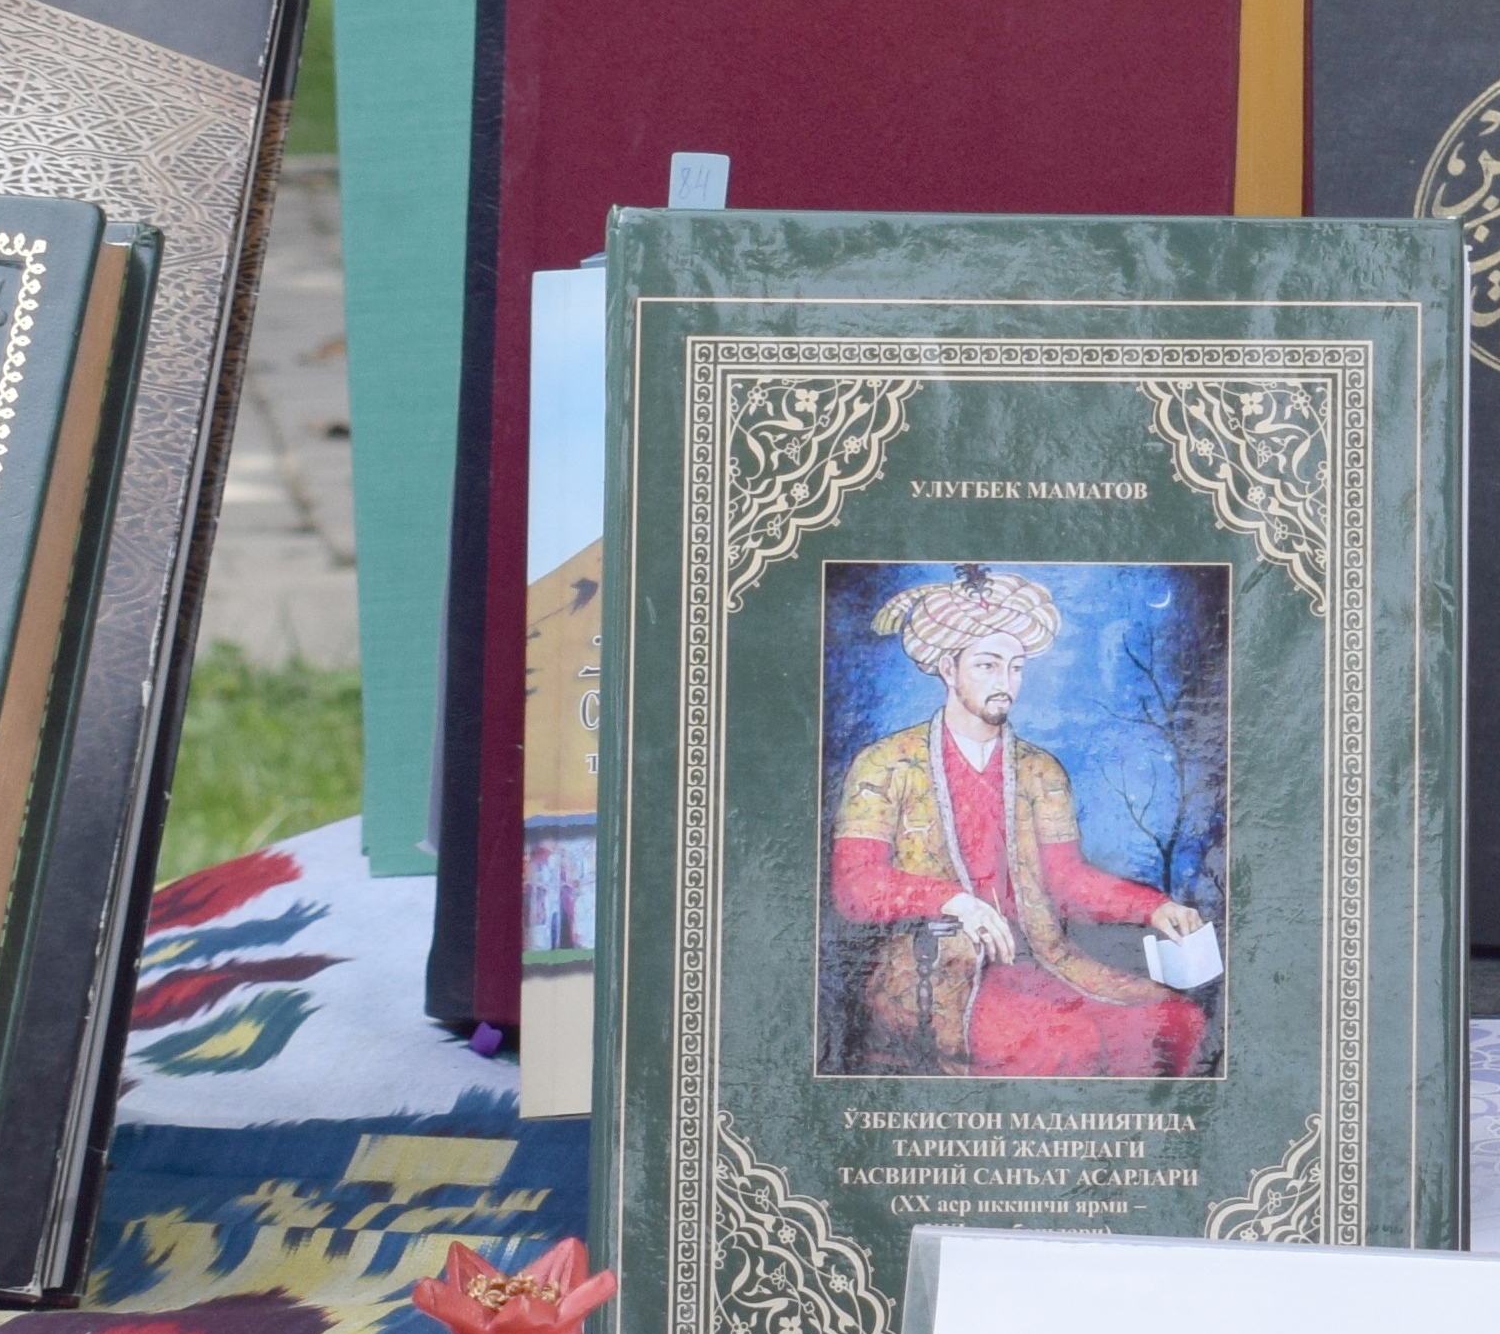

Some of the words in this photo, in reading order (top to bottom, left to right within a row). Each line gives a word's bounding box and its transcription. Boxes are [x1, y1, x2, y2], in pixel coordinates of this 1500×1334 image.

[1027, 482, 1148, 500] МАМАТОВ
[843, 1107, 1001, 1131] ЎЗБЕКИСТОН
[1010, 1111, 1197, 1134] МАДАНИЯТИДА
[892, 1135, 1006, 1158] ТАРИХИЙ
[1013, 1139, 1145, 1161] ЖАНРДАГИ
[839, 1163, 967, 1186] ТАСВИРИЙ
[972, 1167, 1070, 1187] САНЪАТ
[1076, 1168, 1199, 1188] АСАРЛАРИ
[937, 1200, 971, 1217] аср
[977, 1200, 1069, 1213] иккинчи
[1075, 1201, 1128, 1217] ярми
